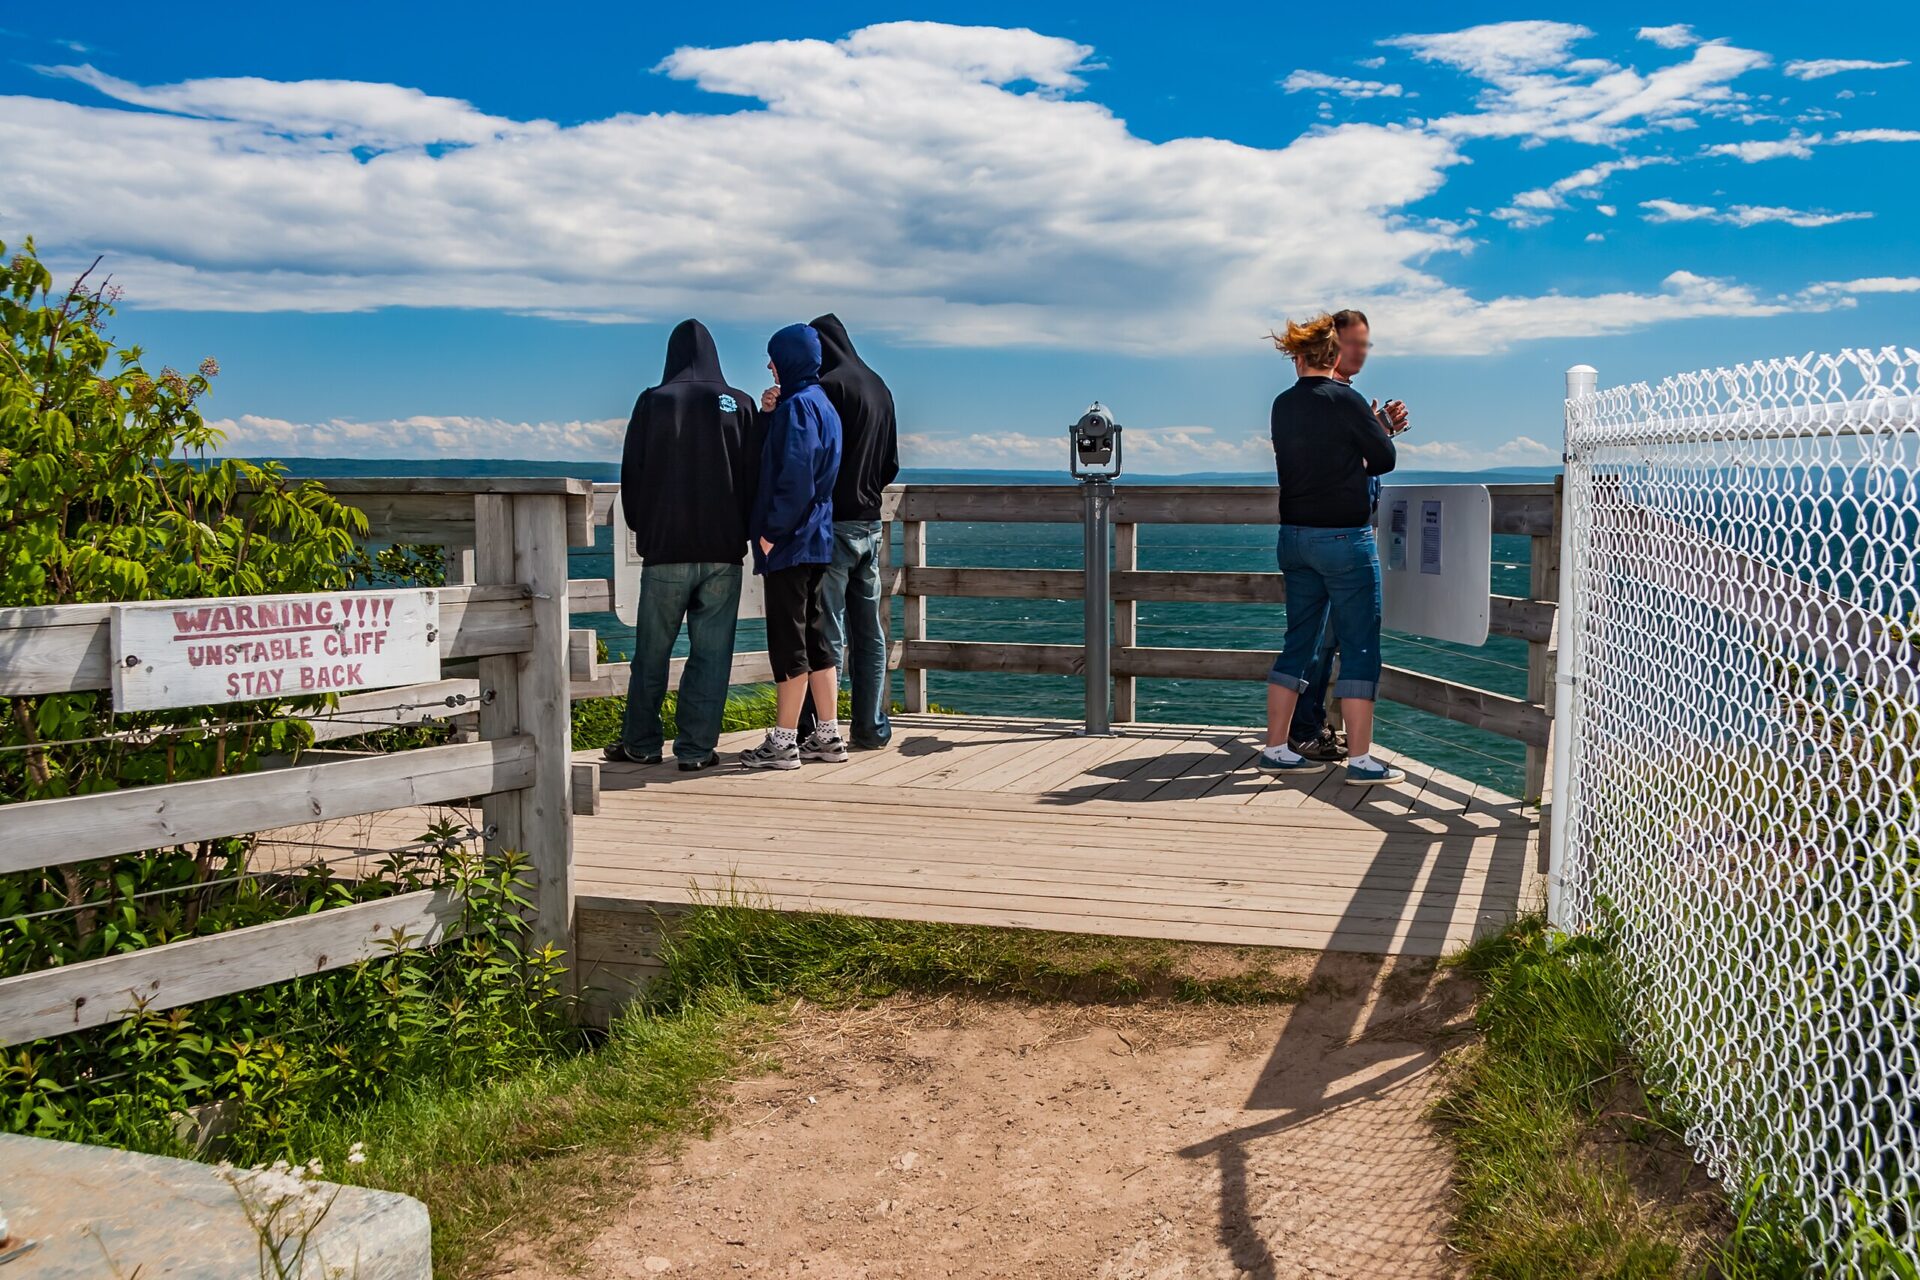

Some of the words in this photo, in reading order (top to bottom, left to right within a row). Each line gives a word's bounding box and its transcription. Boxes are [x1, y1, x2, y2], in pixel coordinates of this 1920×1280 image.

[173, 602, 333, 633] WARNING
[188, 636, 313, 666] UNSTABLE
[324, 630, 387, 657] CLIFF
[226, 668, 285, 697] STAY
[300, 663, 364, 690] BACK
